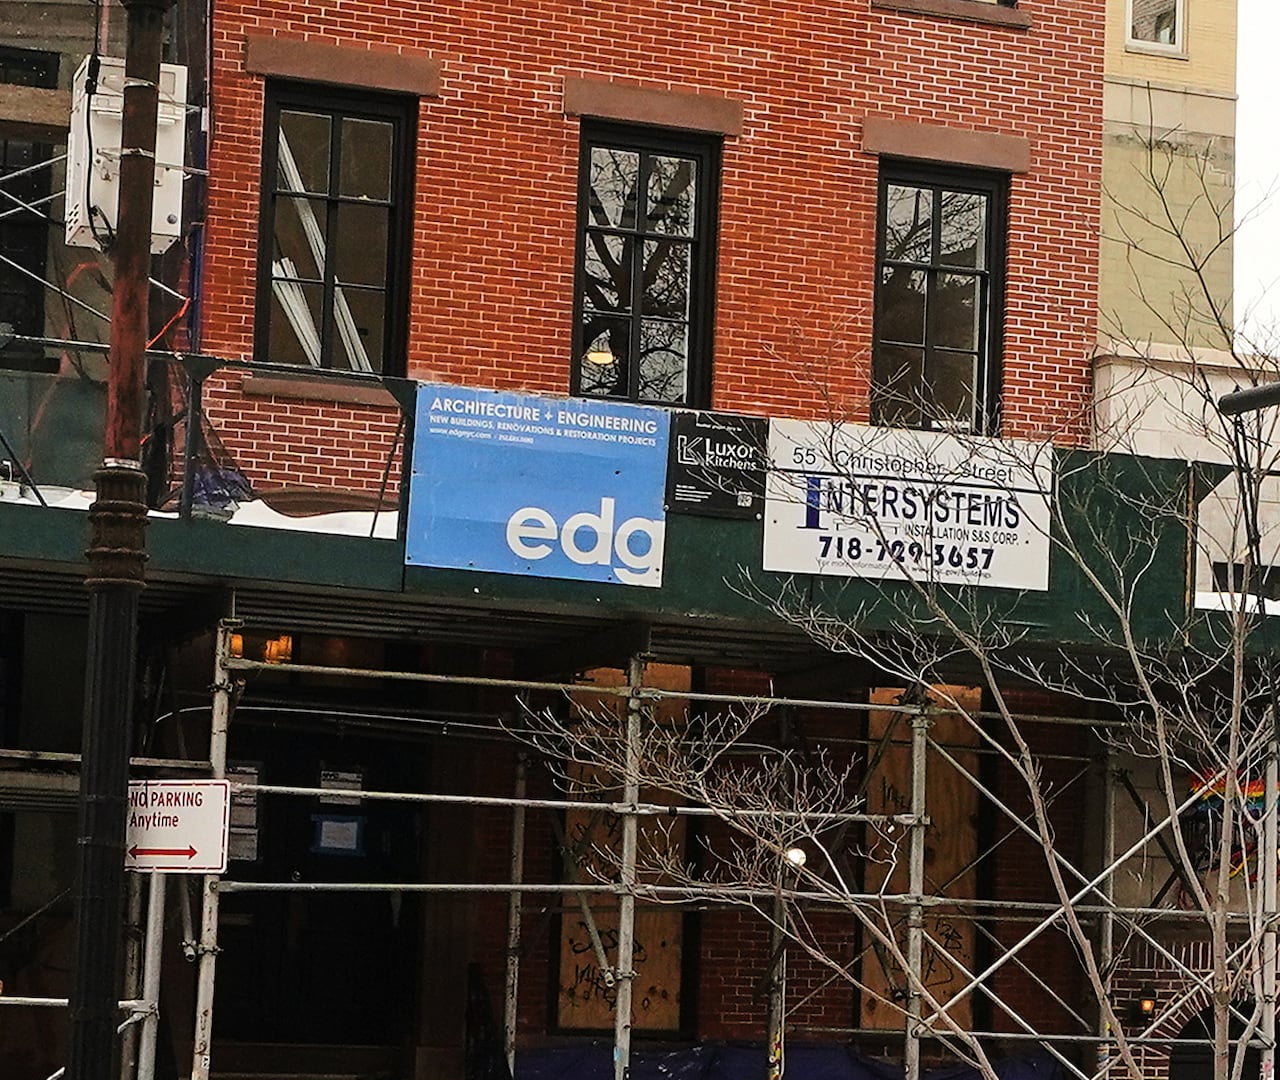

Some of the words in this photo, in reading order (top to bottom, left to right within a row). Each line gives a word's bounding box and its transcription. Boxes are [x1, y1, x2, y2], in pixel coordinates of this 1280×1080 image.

[429, 415, 449, 424] NEW
[497, 421, 553, 435] RENOVATIONS
[564, 429, 617, 442] RESTORATION
[618, 435, 657, 447] PROJECTS
[430, 397, 540, 421] ARCHITECTURE
[557, 411, 657, 434] ENGINEERING
[705, 438, 755, 458] Luxor
[705, 454, 757, 471] Kitchens
[792, 446, 816, 465] 55
[835, 450, 944, 475] Christopher
[961, 462, 1014, 482] Street
[796, 475, 1020, 530] INTERSYSTEMS
[506, 497, 666, 587] edg
[905, 523, 970, 541] INSTALLATION
[818, 535, 995, 570] 718-729-3657
[130, 791, 147, 808] NO
[150, 791, 203, 807] PARKING
[129, 811, 179, 831] Anytime
